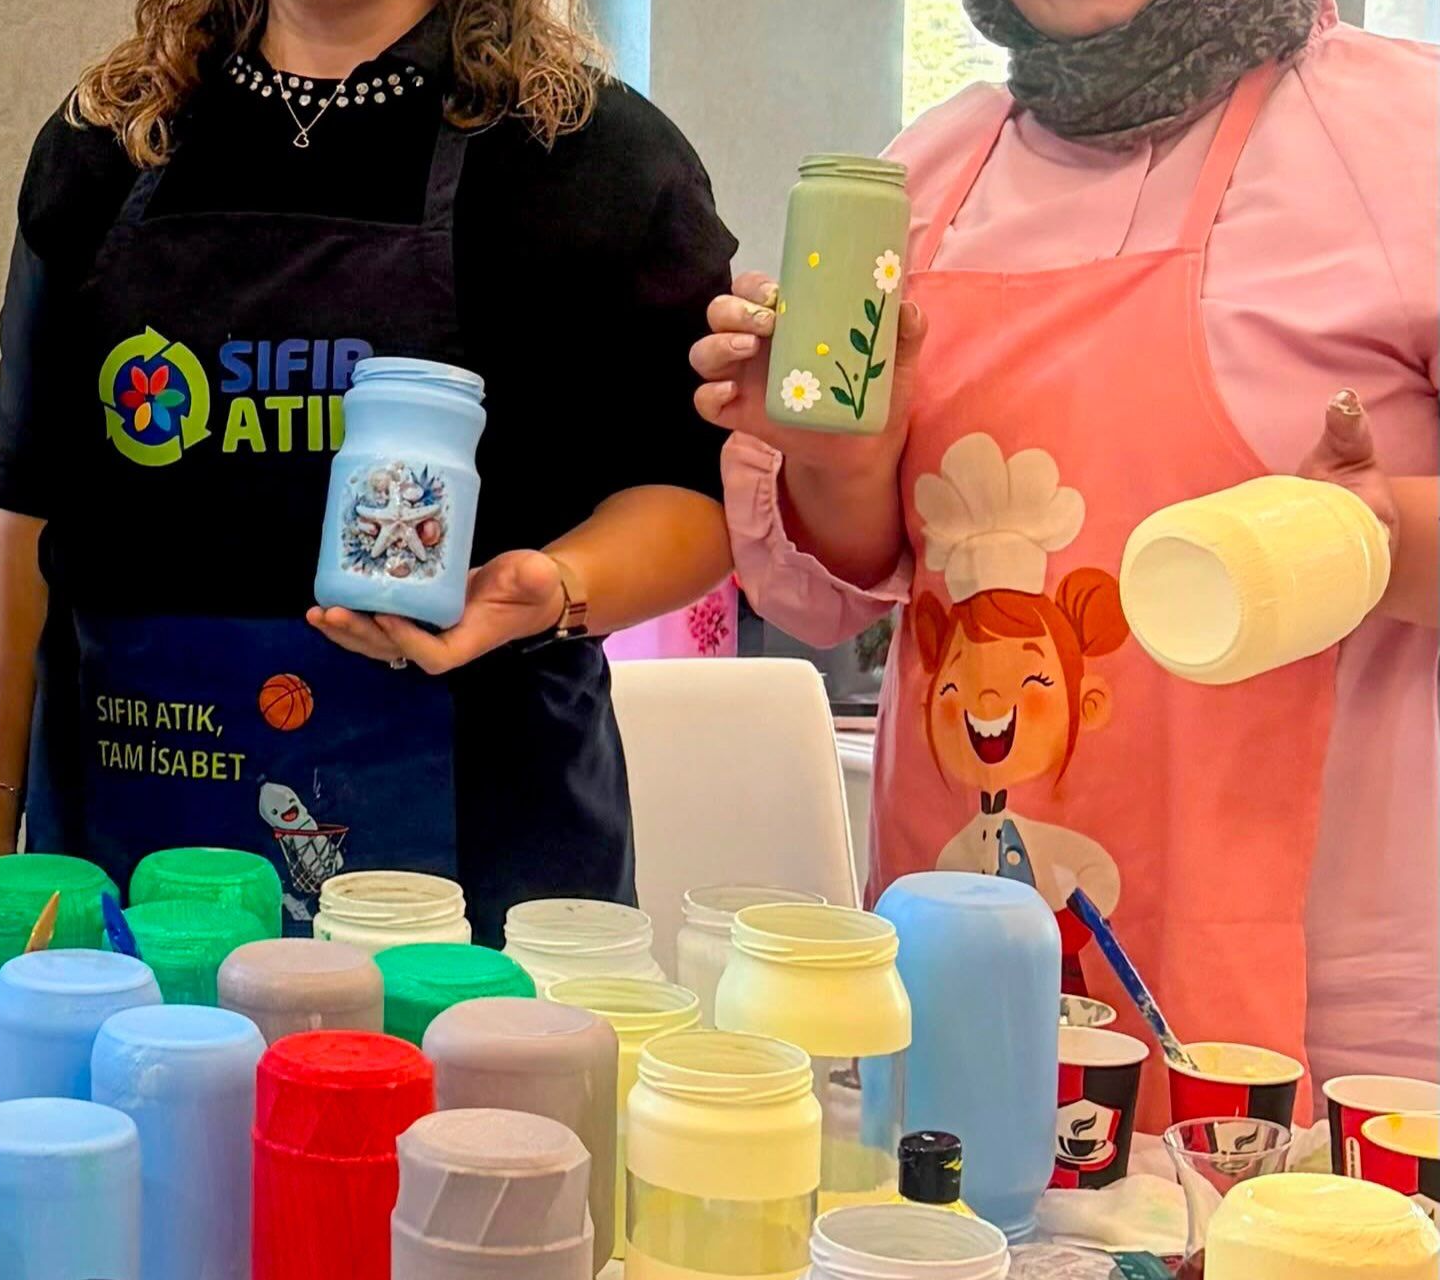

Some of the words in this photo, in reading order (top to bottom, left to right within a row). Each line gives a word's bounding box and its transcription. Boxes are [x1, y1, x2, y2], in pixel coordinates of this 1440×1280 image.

[96, 695, 148, 727] SIFIR
[155, 702, 223, 737] ATIK,
[97, 740, 143, 772] TAM
[150, 740, 245, 781] İSABET
